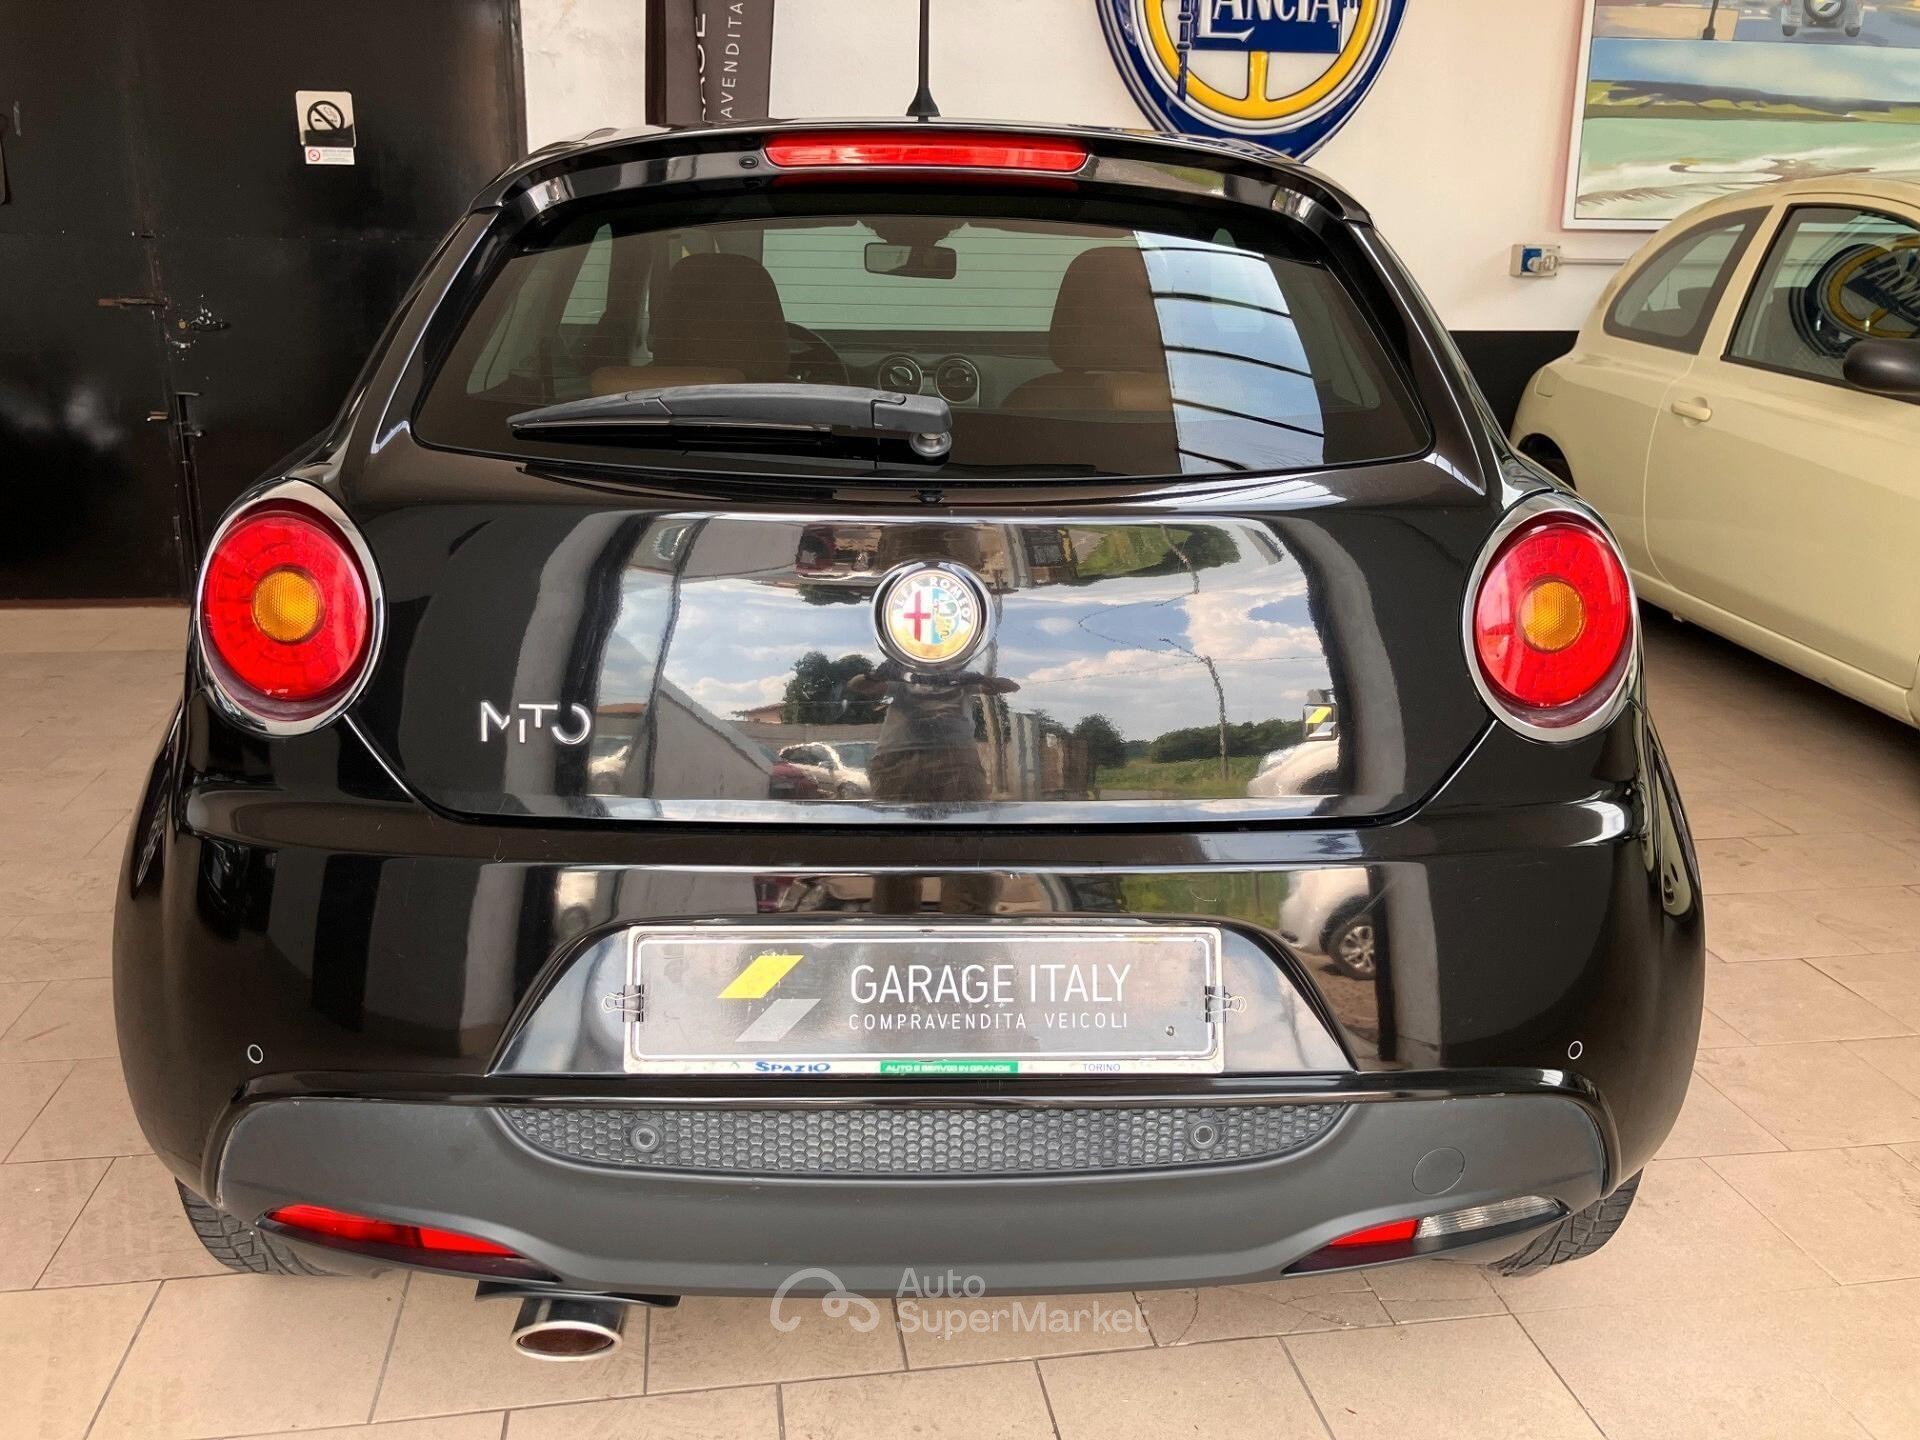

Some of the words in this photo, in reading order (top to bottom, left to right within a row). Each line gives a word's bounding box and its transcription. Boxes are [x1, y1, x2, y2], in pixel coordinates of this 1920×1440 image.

[850, 963, 1014, 1003] GARAGE
[1030, 963, 1131, 1002] ITALY
[848, 1012, 1026, 1030] COMPRAVENDITA
[1045, 1012, 1128, 1029] VEICOLI
[1082, 1063, 1120, 1072] TORINO
